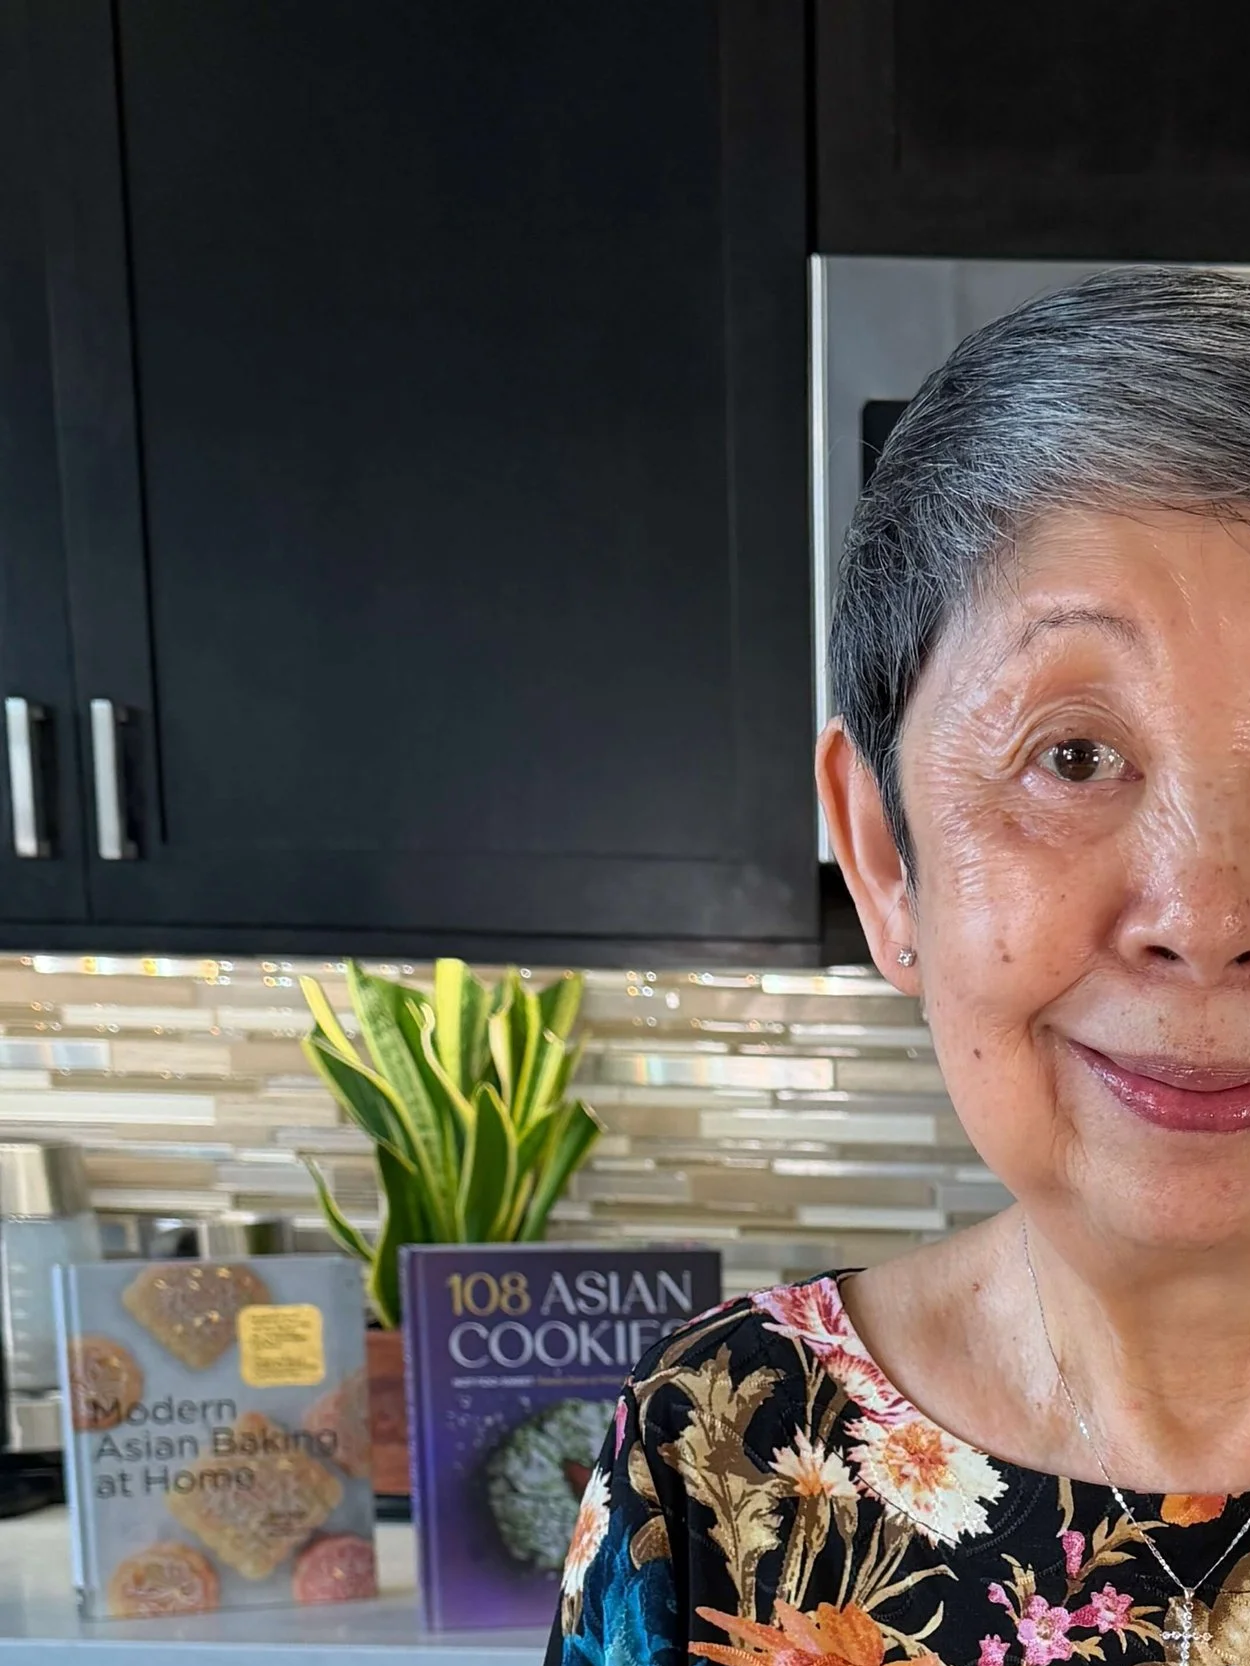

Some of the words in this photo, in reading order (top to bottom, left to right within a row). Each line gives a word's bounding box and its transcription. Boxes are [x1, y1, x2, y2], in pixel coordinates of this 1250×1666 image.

[447, 1271, 531, 1317] 108
[540, 1270, 693, 1316] ASIAN
[90, 1394, 238, 1427] Modern
[96, 1431, 199, 1463] Asian
[211, 1427, 338, 1460] Baking
[96, 1471, 132, 1499] at
[144, 1467, 256, 1495] Home
